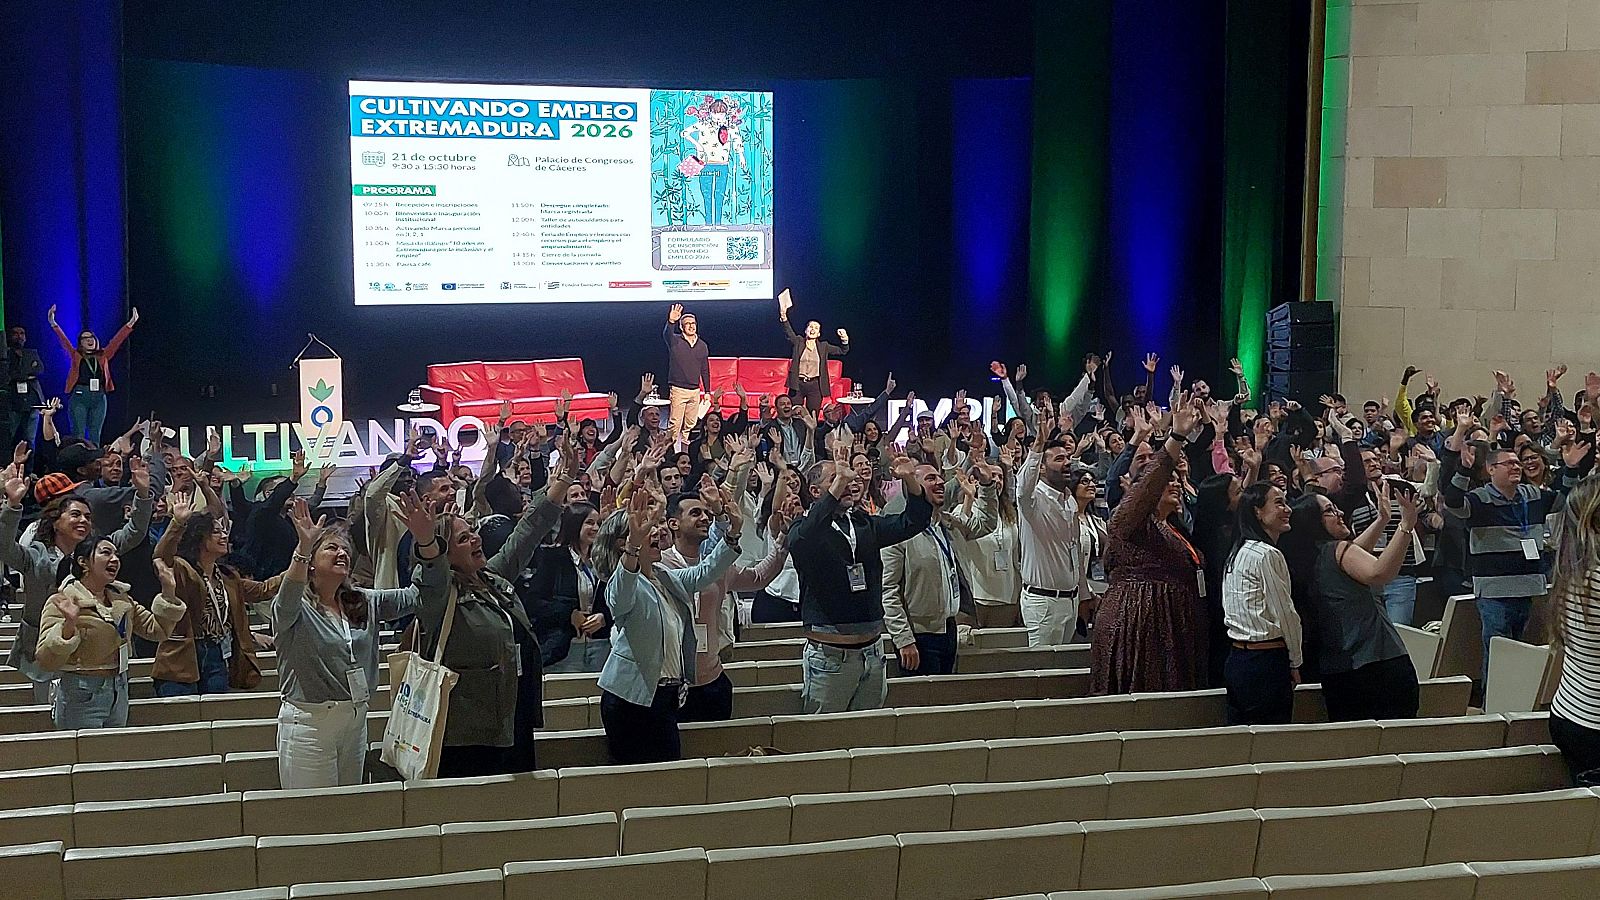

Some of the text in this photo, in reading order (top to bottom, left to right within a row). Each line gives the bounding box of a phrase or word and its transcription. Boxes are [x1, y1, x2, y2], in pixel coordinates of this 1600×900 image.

[359, 98, 635, 120] CULTIVANDO EMPLEO
[361, 119, 633, 138] EXTREMADURA 2026
[392, 153, 477, 162] 21 de octubre
[535, 156, 569, 164] Palacio
[585, 157, 634, 165] Congresos
[363, 186, 433, 195] PROGRAMA
